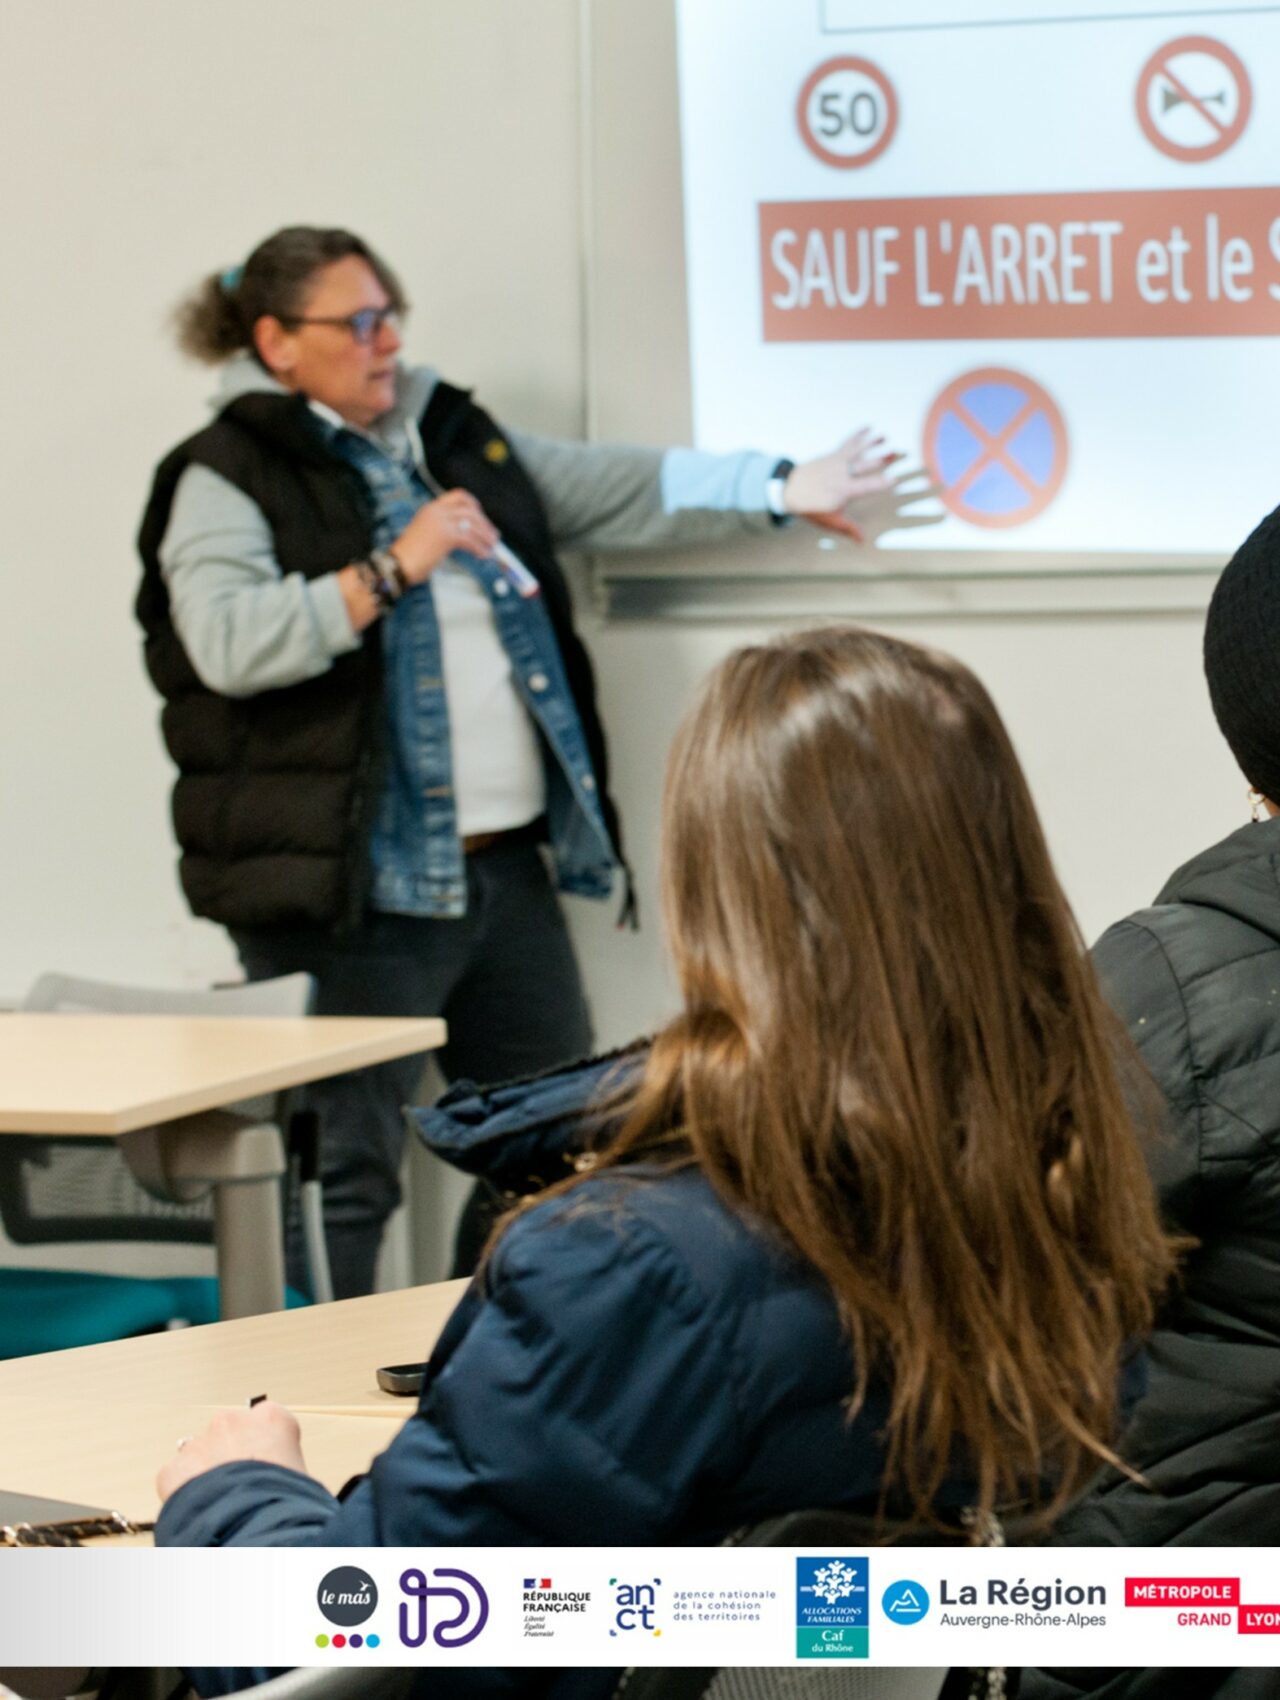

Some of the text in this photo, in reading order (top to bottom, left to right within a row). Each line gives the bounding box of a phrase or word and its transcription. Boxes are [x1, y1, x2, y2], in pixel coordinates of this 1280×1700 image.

[820, 92, 877, 137] 50
[770, 226, 899, 310] SAUF
[914, 219, 1123, 306] L'ARRET
[1136, 226, 1191, 304] et
[1205, 213, 1253, 302] le
